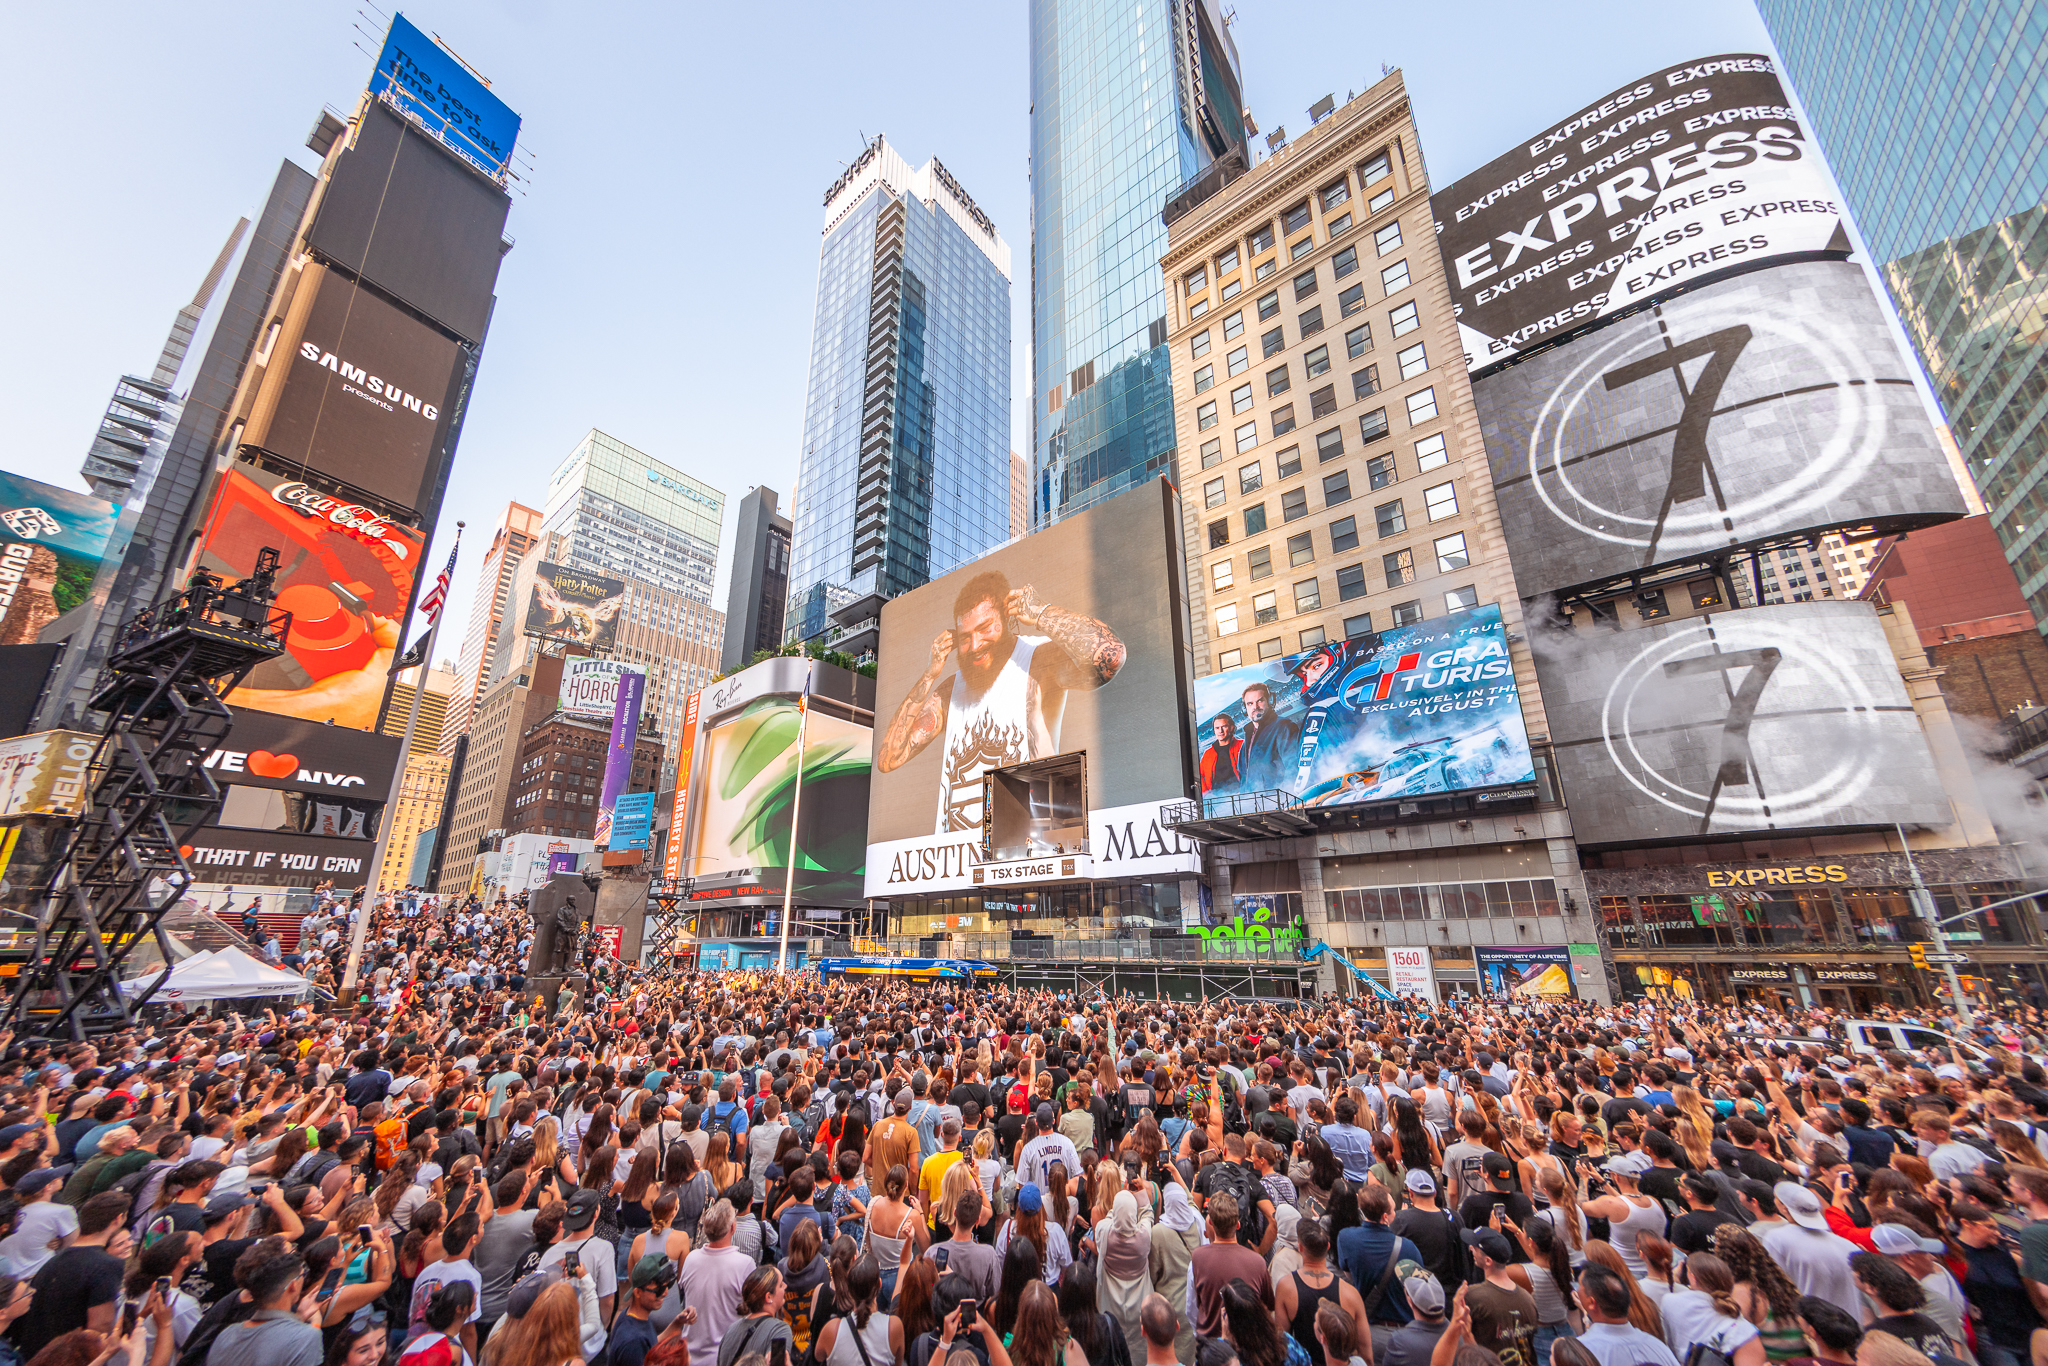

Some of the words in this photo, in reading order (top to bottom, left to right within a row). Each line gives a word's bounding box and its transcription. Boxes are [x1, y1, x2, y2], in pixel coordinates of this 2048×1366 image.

[394, 45, 432, 85] The
[438, 83, 482, 126] best
[388, 59, 436, 104] time
[442, 101, 462, 124] to
[468, 125, 501, 156] ask
[1529, 82, 1654, 157] EXPRESS
[1666, 58, 1776, 88] EXPRESS
[823, 133, 883, 206] EDITION
[1456, 153, 1568, 223] EXPRESS
[1582, 88, 1712, 154] EXPRESS
[1542, 128, 1670, 202] EXPRESS
[1684, 105, 1798, 134] EXPRESS
[933, 154, 996, 238] EDITION
[1454, 126, 1805, 290] EXPRESS
[1475, 240, 1594, 307] EXPRESS
[1609, 180, 1747, 242] EXPRESS
[1567, 222, 1704, 291] EXPRESS
[1720, 200, 1838, 226] EXPRESS
[1488, 292, 1610, 356] EXPRESS
[1626, 234, 1768, 294] EXPRESS
[300, 342, 438, 420] SAMSUNG
[342, 383, 393, 412] presents
[1602, 324, 1753, 504] 7
[271, 481, 396, 538] Coca-Cola
[661, 476, 718, 510] BARCLAYS
[552, 576, 580, 591] Harry
[580, 580, 608, 598] Potter
[571, 571, 606, 584] BROADWAY
[1356, 643, 1406, 656] BASED
[1413, 636, 1434, 646] ON
[1440, 632, 1450, 640] A
[1458, 622, 1503, 636] TRUE
[1426, 641, 1509, 668] GRA
[572, 662, 614, 675] LITTLE
[1400, 660, 1513, 692] TURIS
[568, 678, 620, 706] HORRO
[712, 678, 742, 710] Ray-Ban
[1362, 692, 1463, 714] EXCLUSIVELY
[1467, 689, 1484, 698] IN
[1488, 684, 1517, 694] THE
[1408, 696, 1498, 718] AUGUST
[1507, 693, 1518, 704] 1
[1663, 646, 1782, 786] 7
[45, 738, 98, 812] HELLO!
[670, 789, 686, 854] HERSHEY'S
[1102, 818, 1201, 862] MAL
[194, 847, 250, 866] THAT
[252, 851, 276, 868] IF
[280, 853, 318, 870] YOU
[322, 856, 362, 873] CAN
[991, 868, 1012, 879] TSX
[1016, 864, 1054, 877] STAGE
[1706, 864, 1848, 888] EXPRESS
[737, 886, 750, 895] NEW
[1392, 952, 1420, 965] 1560
[1733, 970, 1788, 979] EXPRESS
[1816, 971, 1877, 980] EXPRESS
[1038, 1146, 1062, 1158] LINDOR
[523, 1252, 541, 1270] Ra
